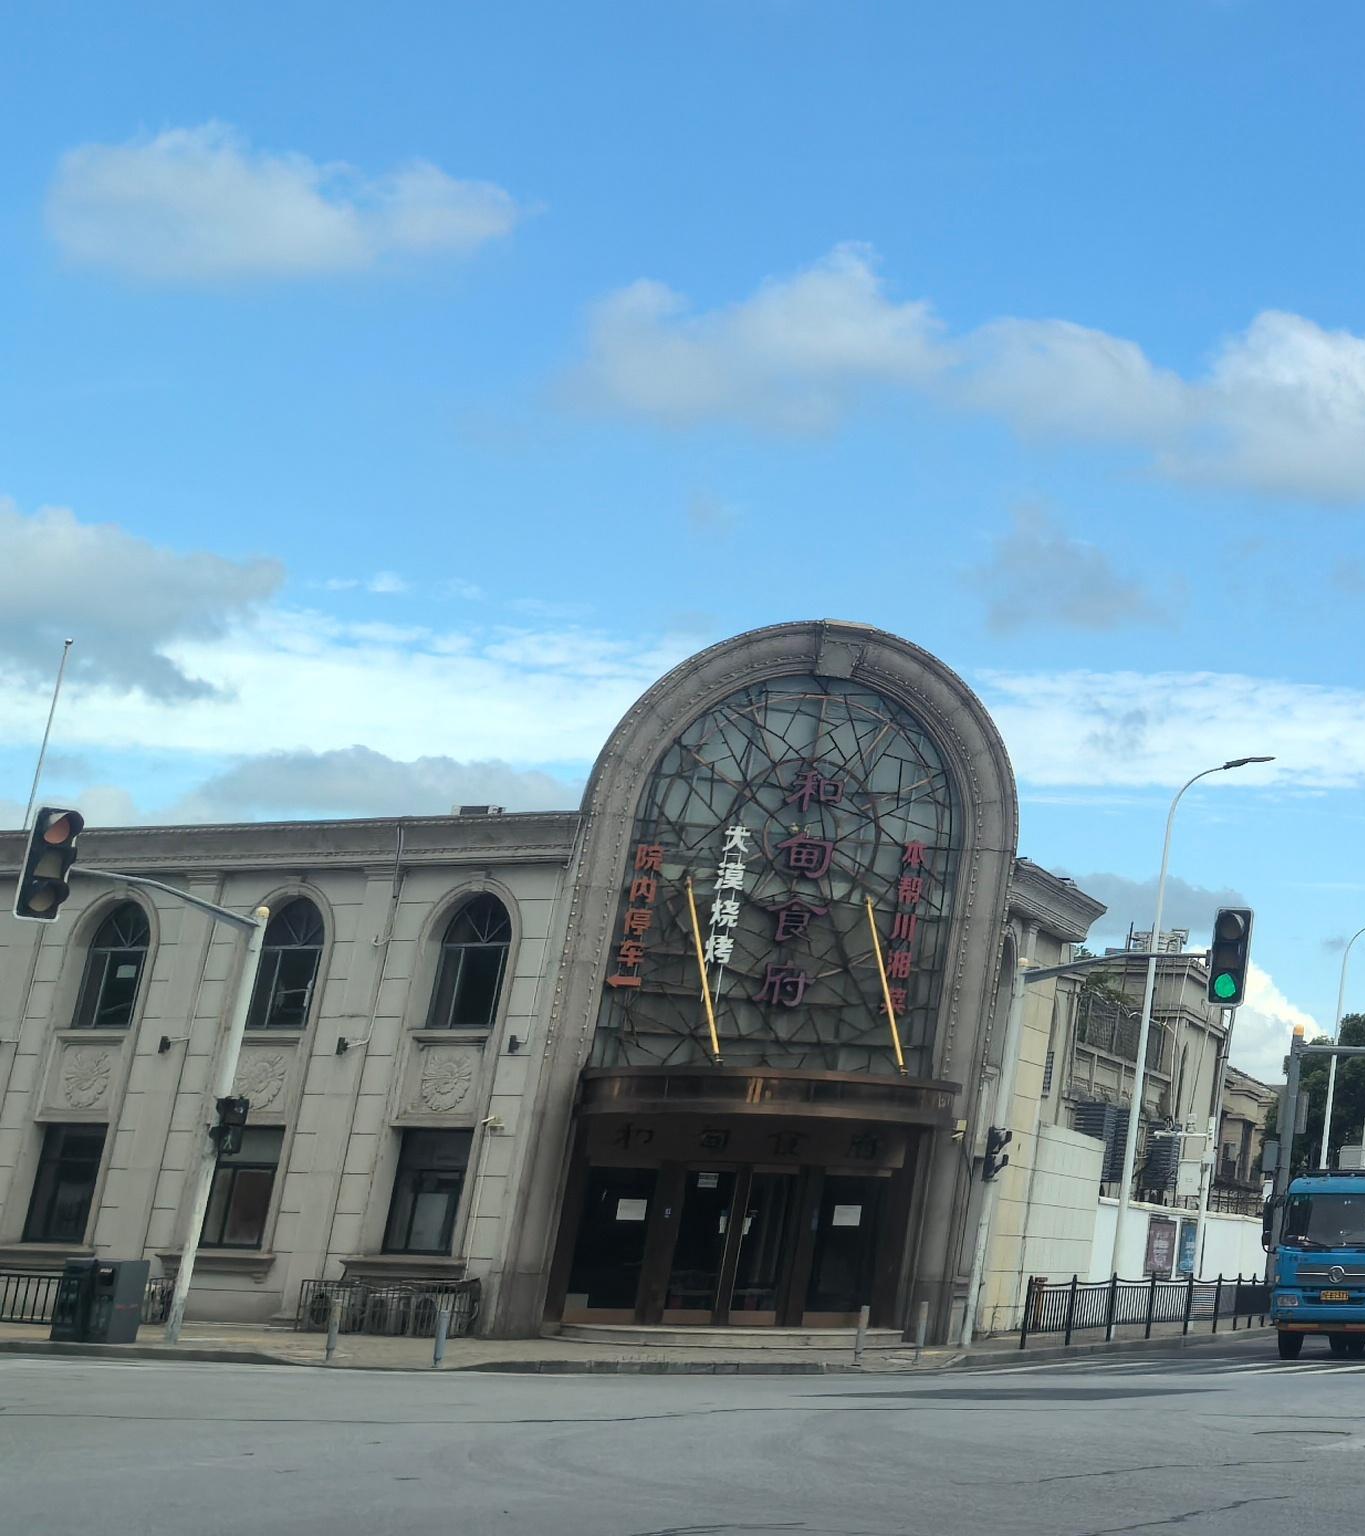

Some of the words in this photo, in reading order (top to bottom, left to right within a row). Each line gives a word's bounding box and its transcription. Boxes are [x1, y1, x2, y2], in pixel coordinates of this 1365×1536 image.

[615, 842, 664, 968] 院内停车
[705, 825, 751, 964] 大漠烧烤
[752, 768, 844, 1007] 和甸食府
[880, 839, 926, 1015] 本帮川湘菜
